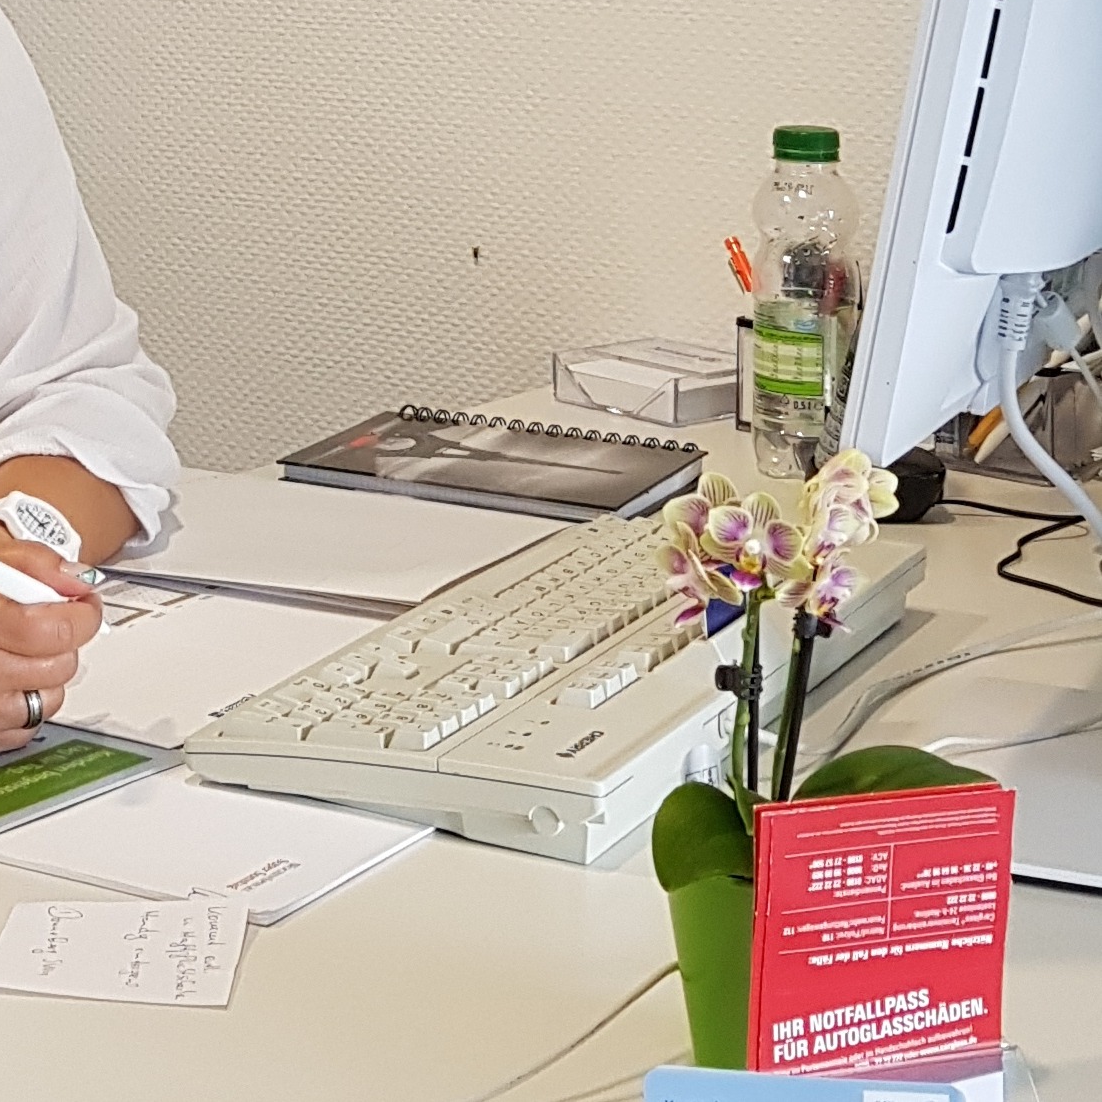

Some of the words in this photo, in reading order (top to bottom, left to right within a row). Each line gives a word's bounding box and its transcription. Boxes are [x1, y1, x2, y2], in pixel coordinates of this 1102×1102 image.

[852, 950, 869, 961] Fall
[773, 1018, 804, 1042] IHR
[809, 988, 929, 1034] NOTFALLPASS
[773, 1038, 809, 1064] FÜR
[813, 996, 989, 1054] AUTOGLASSCHÄDEN.
